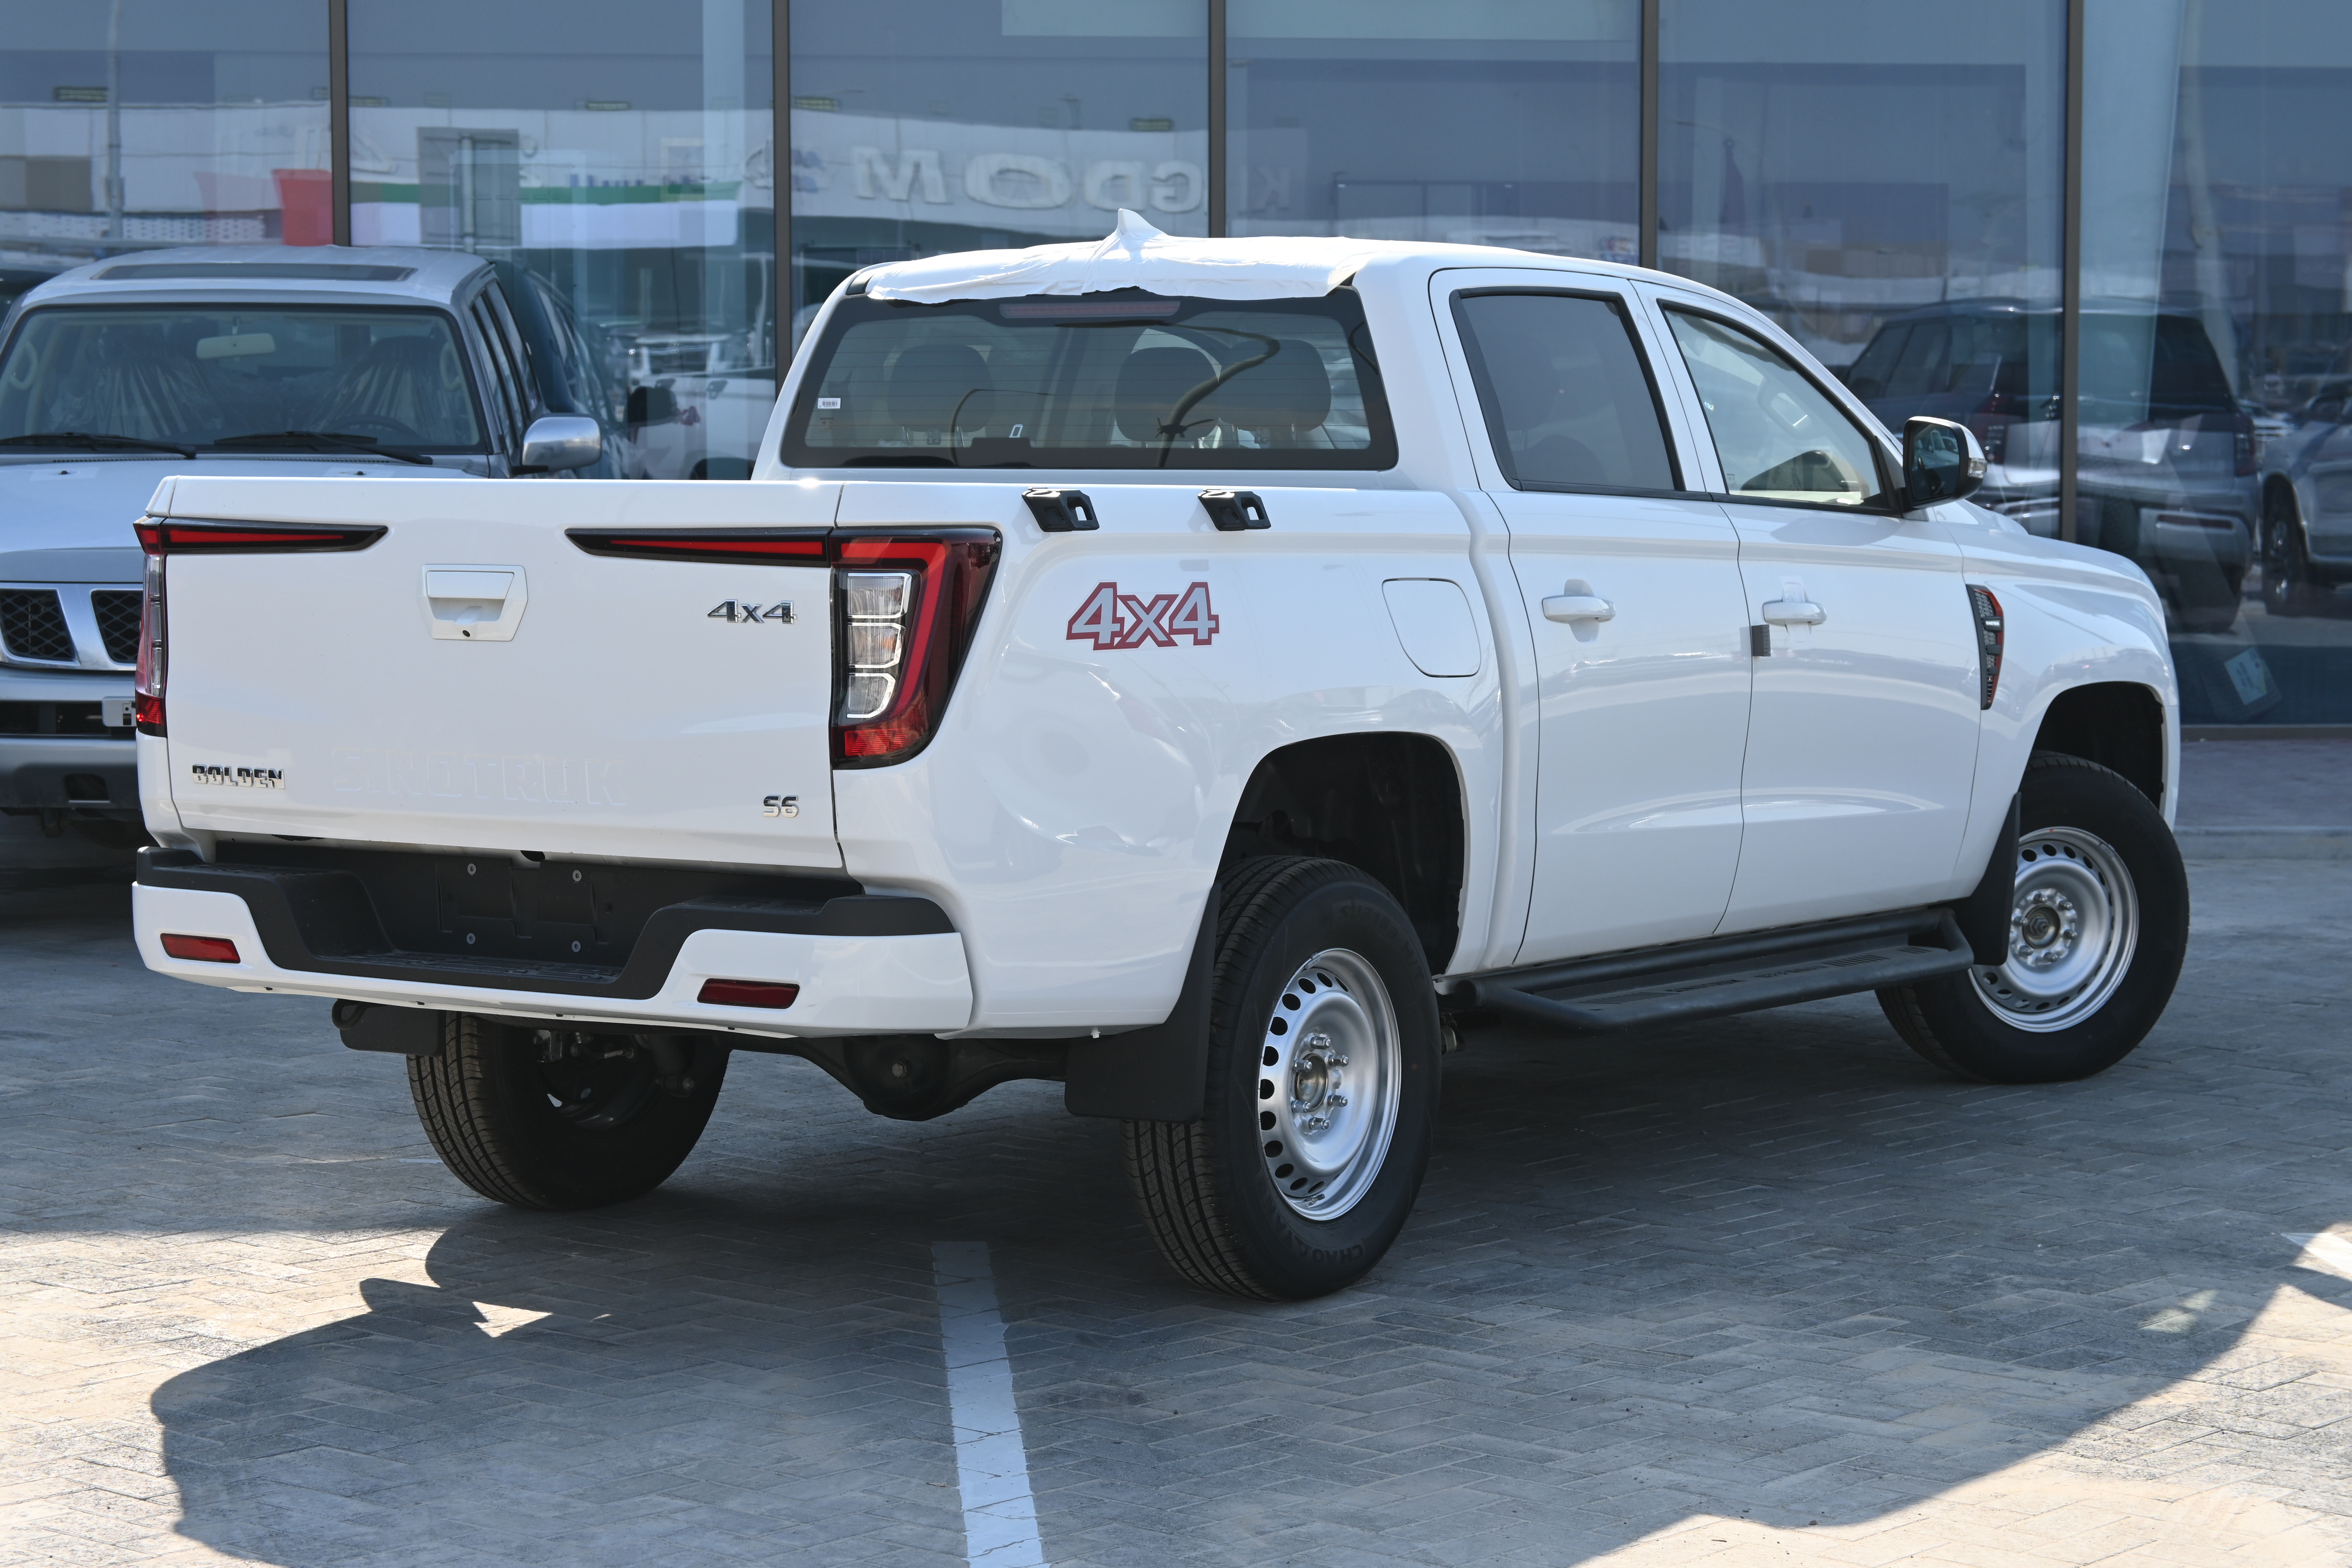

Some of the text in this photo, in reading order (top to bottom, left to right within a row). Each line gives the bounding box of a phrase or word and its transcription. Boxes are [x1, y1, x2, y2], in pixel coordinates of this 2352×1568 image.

[707, 599, 798, 624] 4x4
[1065, 581, 1220, 651] 4x4
[192, 764, 286, 789] BOLDEN
[332, 746, 628, 806] SINOTRUK
[763, 795, 799, 818] S6
